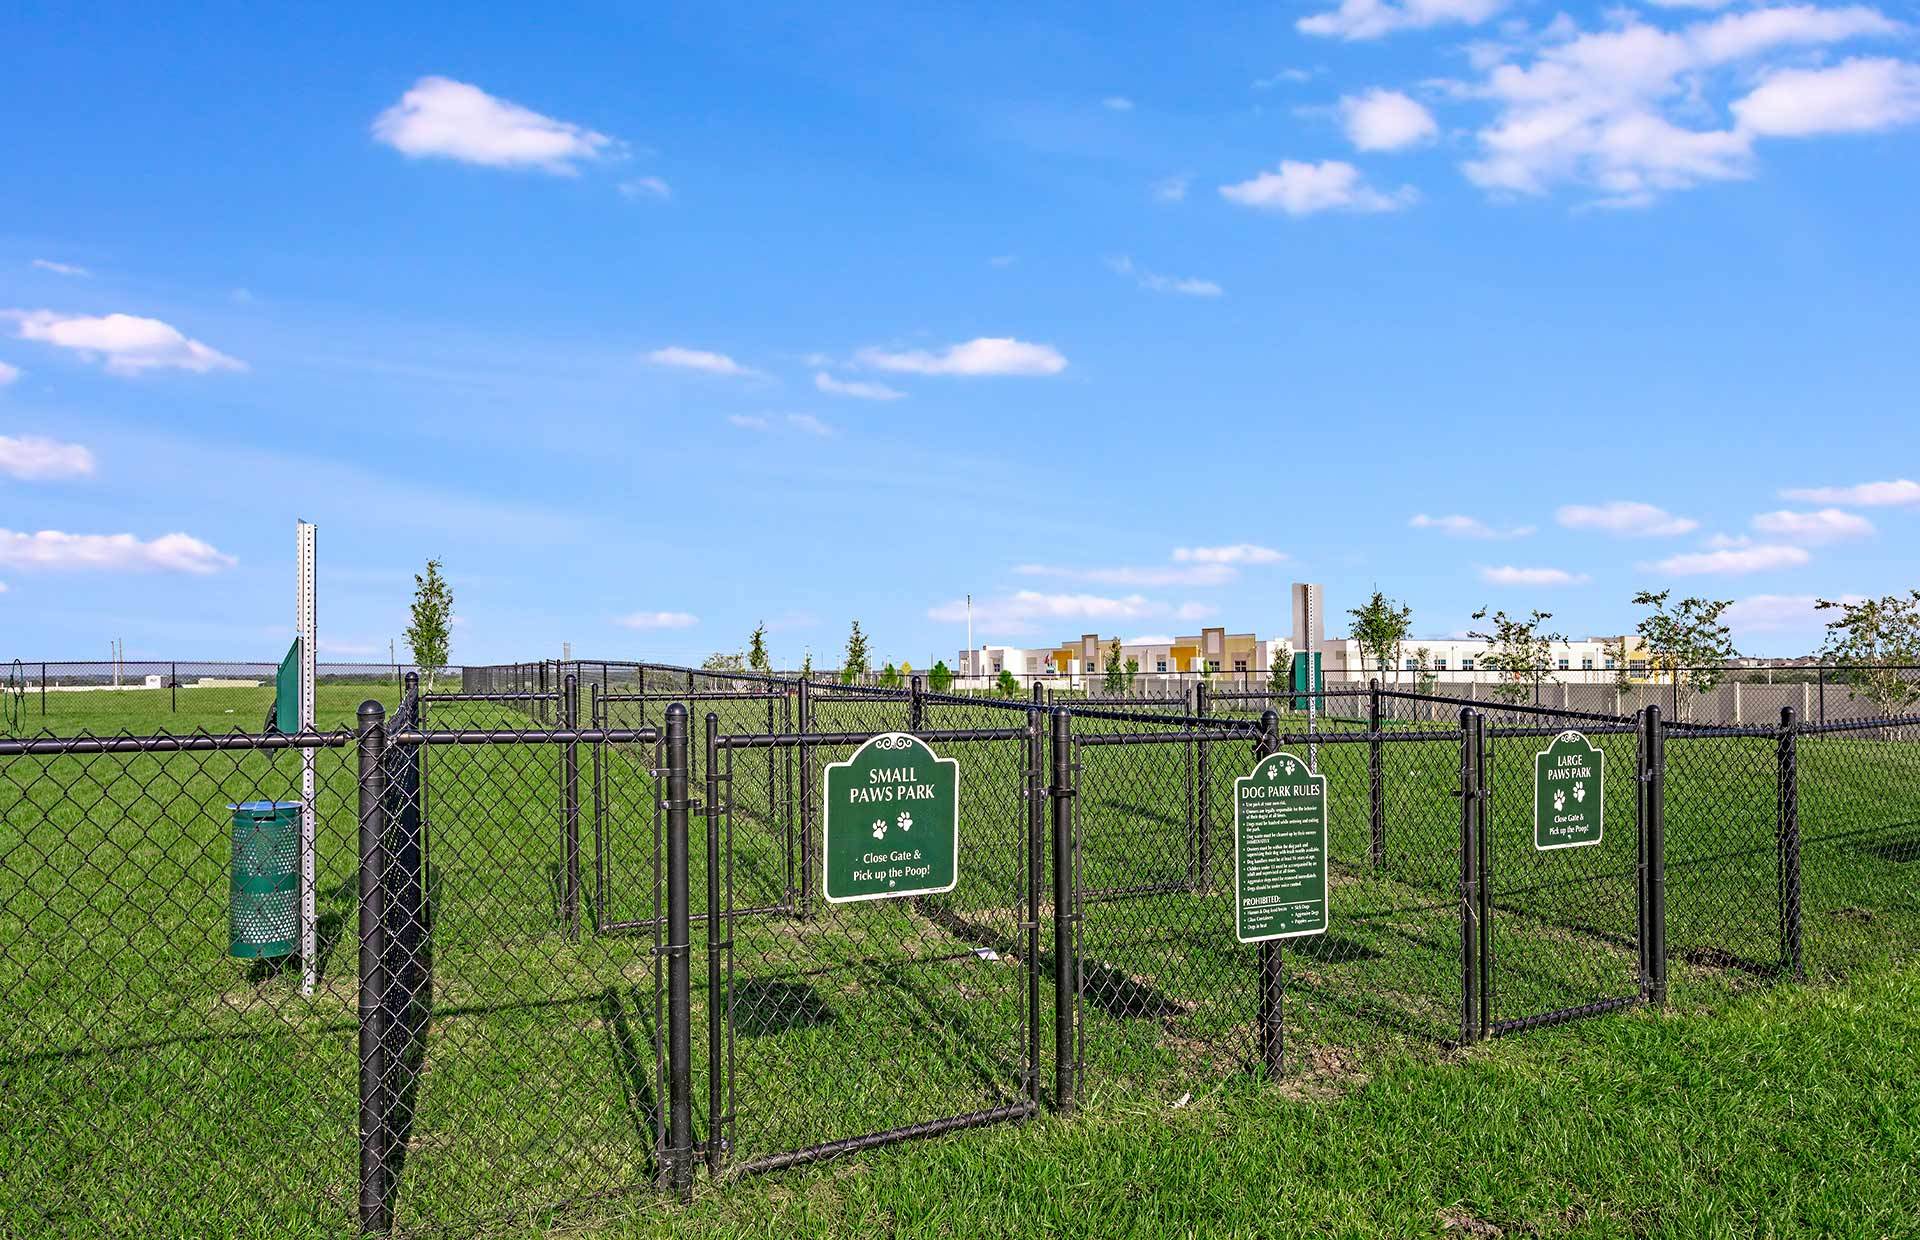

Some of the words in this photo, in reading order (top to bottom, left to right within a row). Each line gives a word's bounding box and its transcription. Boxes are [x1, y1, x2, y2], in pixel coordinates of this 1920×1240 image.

[1558, 755, 1582, 766] LARGE
[870, 768, 917, 784] SMALL
[1548, 769, 1569, 780] PAWS
[1572, 767, 1591, 778] PARK
[850, 787, 893, 803] PAWS
[898, 784, 935, 800] PARK
[1242, 787, 1264, 798] DOG
[1268, 785, 1291, 797] PARK
[1294, 784, 1320, 796] RULES
[1554, 815, 1567, 823] Close
[1576, 825, 1589, 834] Poop!
[863, 852, 887, 864] Close
[890, 851, 911, 861] Gate
[914, 850, 921, 859] &
[853, 869, 873, 881] Pick
[875, 871, 886, 882] up
[889, 867, 902, 878] the
[905, 865, 930, 878] Poop!
[1243, 895, 1280, 906] PROHIBITED:
